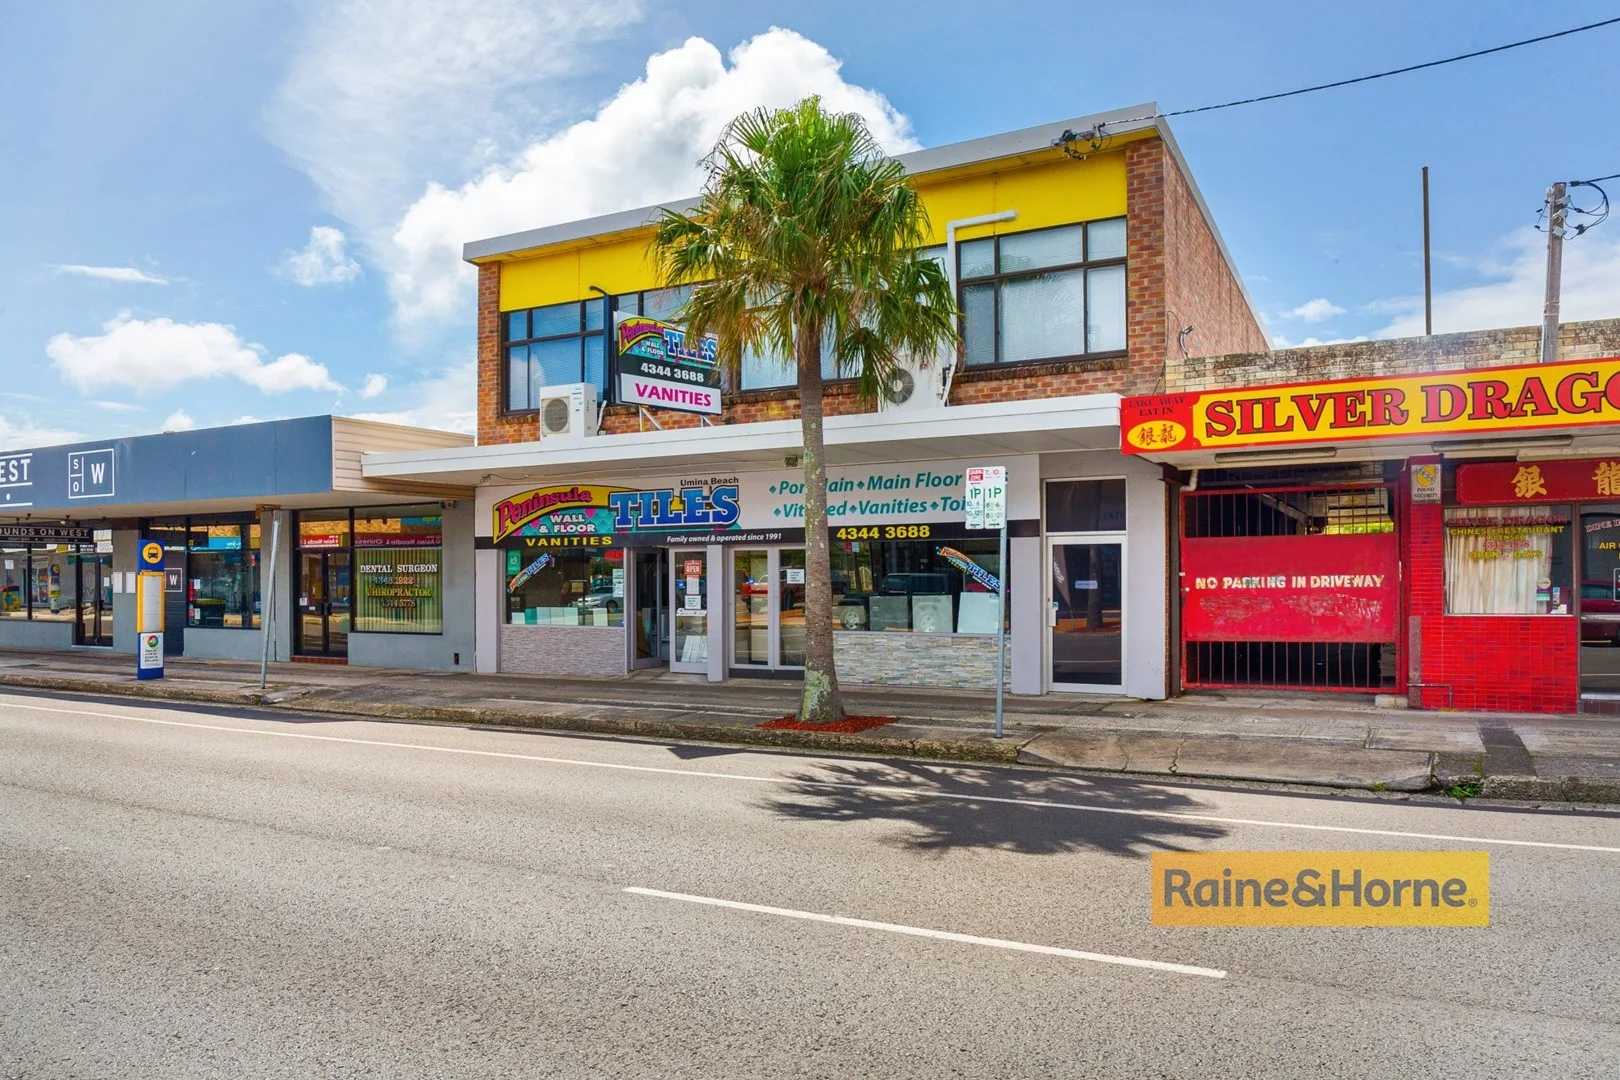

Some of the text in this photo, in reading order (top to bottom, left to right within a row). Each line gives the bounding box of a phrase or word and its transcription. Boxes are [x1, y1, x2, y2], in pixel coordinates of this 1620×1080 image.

[640, 361, 704, 383] 4344 3688
[635, 382, 711, 408] VANITIES
[1158, 396, 1185, 406] AWAY
[1139, 407, 1173, 417] EAT IN
[1205, 388, 1409, 438] SILVER
[90, 462, 105, 485] W
[680, 476, 739, 487] Umina Beach
[779, 472, 963, 495] Porlain Main Floor
[970, 487, 1002, 499] 1P 1P
[496, 487, 593, 538] Peninsula
[609, 484, 740, 529] TILES
[783, 500, 848, 518] Vited
[859, 497, 928, 515] Vanities
[550, 514, 585, 523] WALL
[1446, 514, 1568, 527] SILVER DRAGON
[39, 528, 55, 536] ON
[60, 529, 89, 537] WEST
[538, 523, 596, 533] & FLOOR
[836, 525, 931, 540] 4344 3688
[1450, 526, 1565, 536] CHINESE RESTAURANT
[525, 536, 613, 547] VANITIES
[666, 535, 687, 545] Family
[688, 534, 709, 543] owned
[716, 533, 748, 544] operated
[748, 533, 765, 541] since
[1469, 550, 1500, 559] OPEN
[1513, 549, 1543, 559] DAYS
[359, 564, 438, 573] DENTAL SURGEON
[169, 574, 178, 586] W
[1195, 575, 1384, 589] NO PARKING IN DRIVEWAY
[366, 588, 431, 597] CHIROPRACTOR
